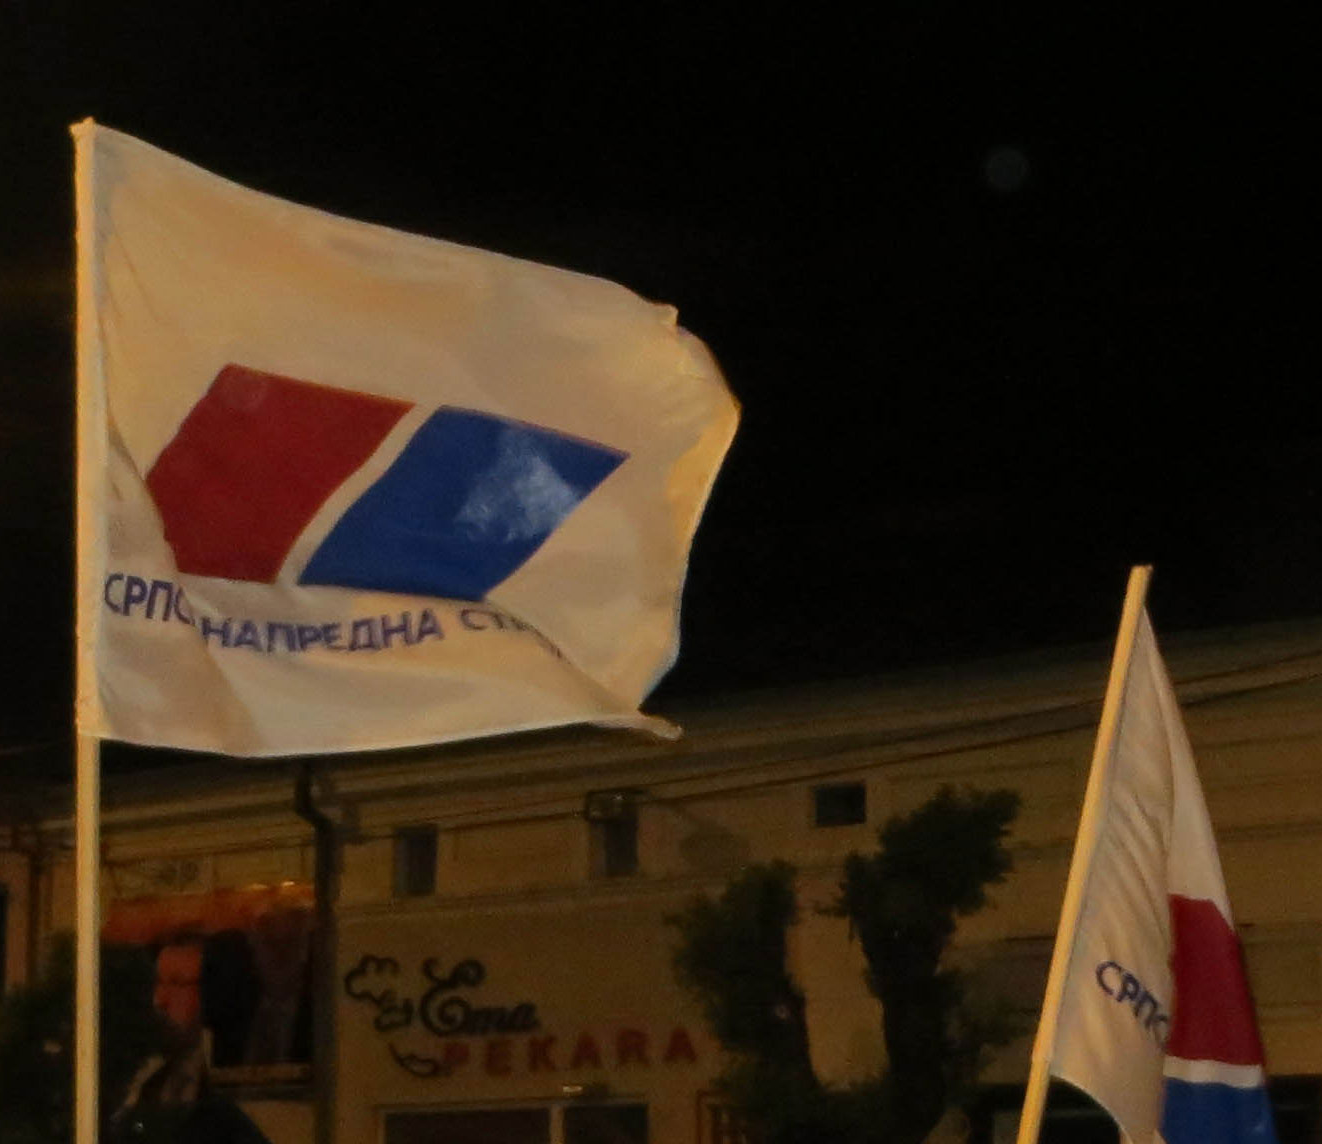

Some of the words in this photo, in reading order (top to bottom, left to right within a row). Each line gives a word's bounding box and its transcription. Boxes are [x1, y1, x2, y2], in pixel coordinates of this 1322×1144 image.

[104, 573, 196, 627] СРПС
[201, 607, 445, 653] НАПРЕДНА
[443, 1026, 696, 1077] PEKARA
